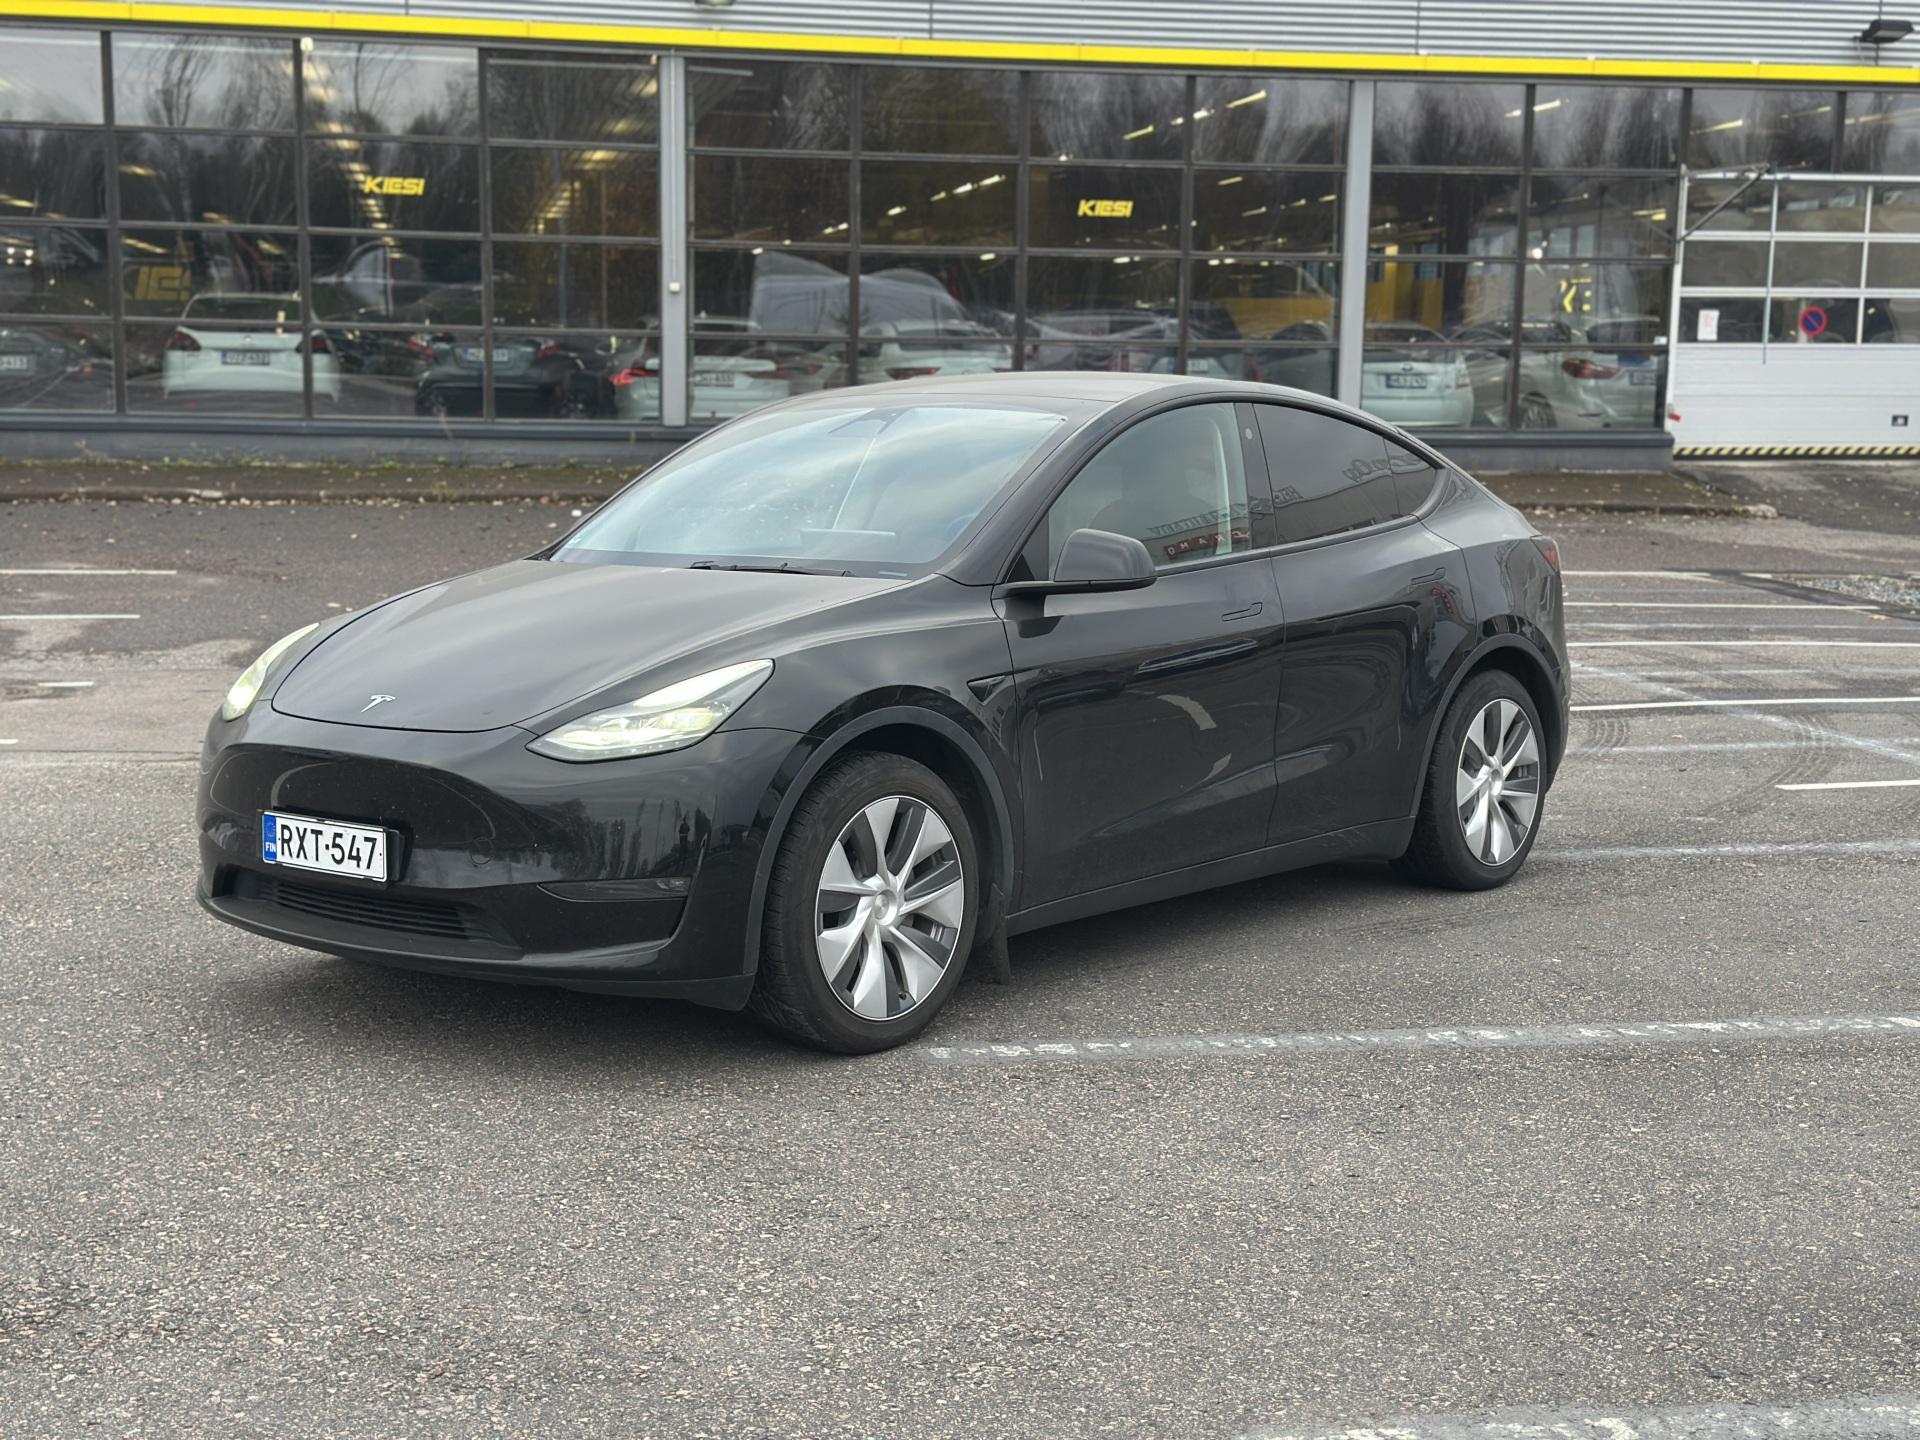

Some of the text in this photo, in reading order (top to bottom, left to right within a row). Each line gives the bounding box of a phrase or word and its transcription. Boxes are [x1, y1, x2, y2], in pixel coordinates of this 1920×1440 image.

[363, 176, 425, 195] KIESI
[1077, 199, 1134, 217] KIESI
[265, 841, 277, 853] FIN
[280, 823, 378, 870] RXT-547
